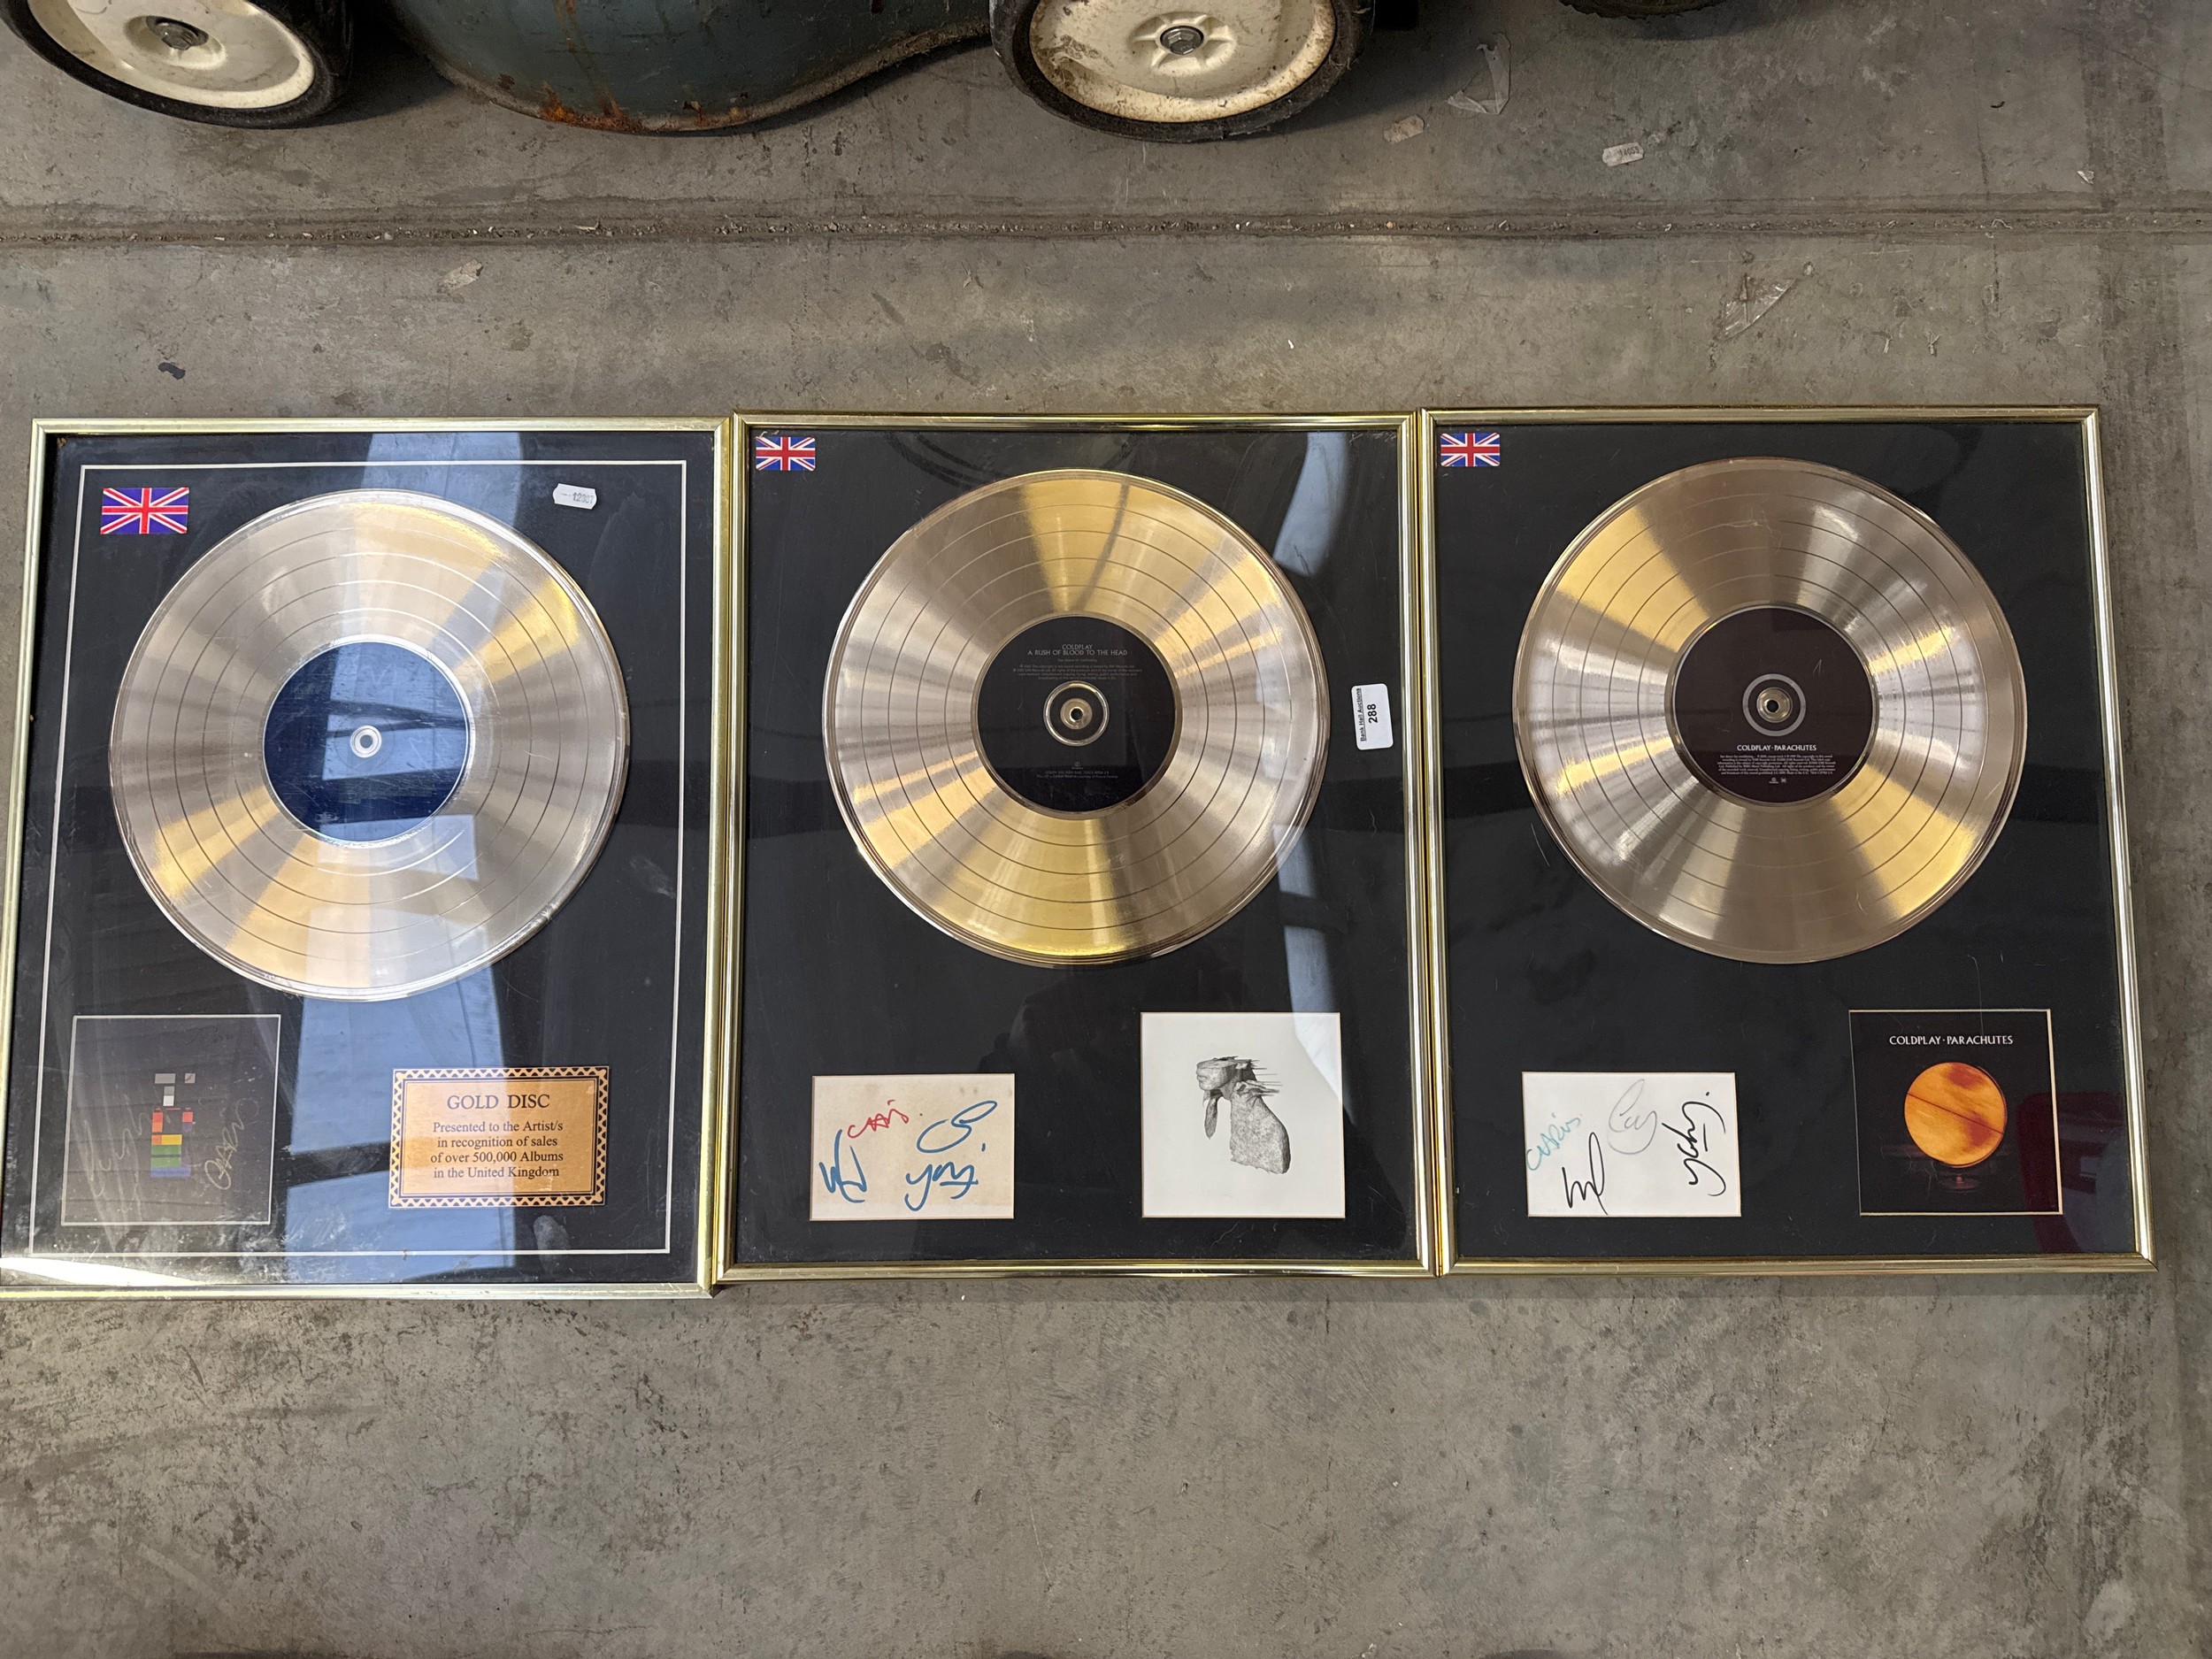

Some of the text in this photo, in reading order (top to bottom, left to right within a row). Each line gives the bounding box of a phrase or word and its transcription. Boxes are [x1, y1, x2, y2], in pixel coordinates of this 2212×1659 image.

[1367, 703, 1378, 724] 288
[447, 1094, 550, 1110] GOLD DISC
[433, 1120, 564, 1133] Presented to the Artist/s
[437, 1136, 558, 1150] in recognition of sales
[430, 1151, 564, 1164] of over 500,000 Albums
[434, 1166, 560, 1179] in the United Kingdom
